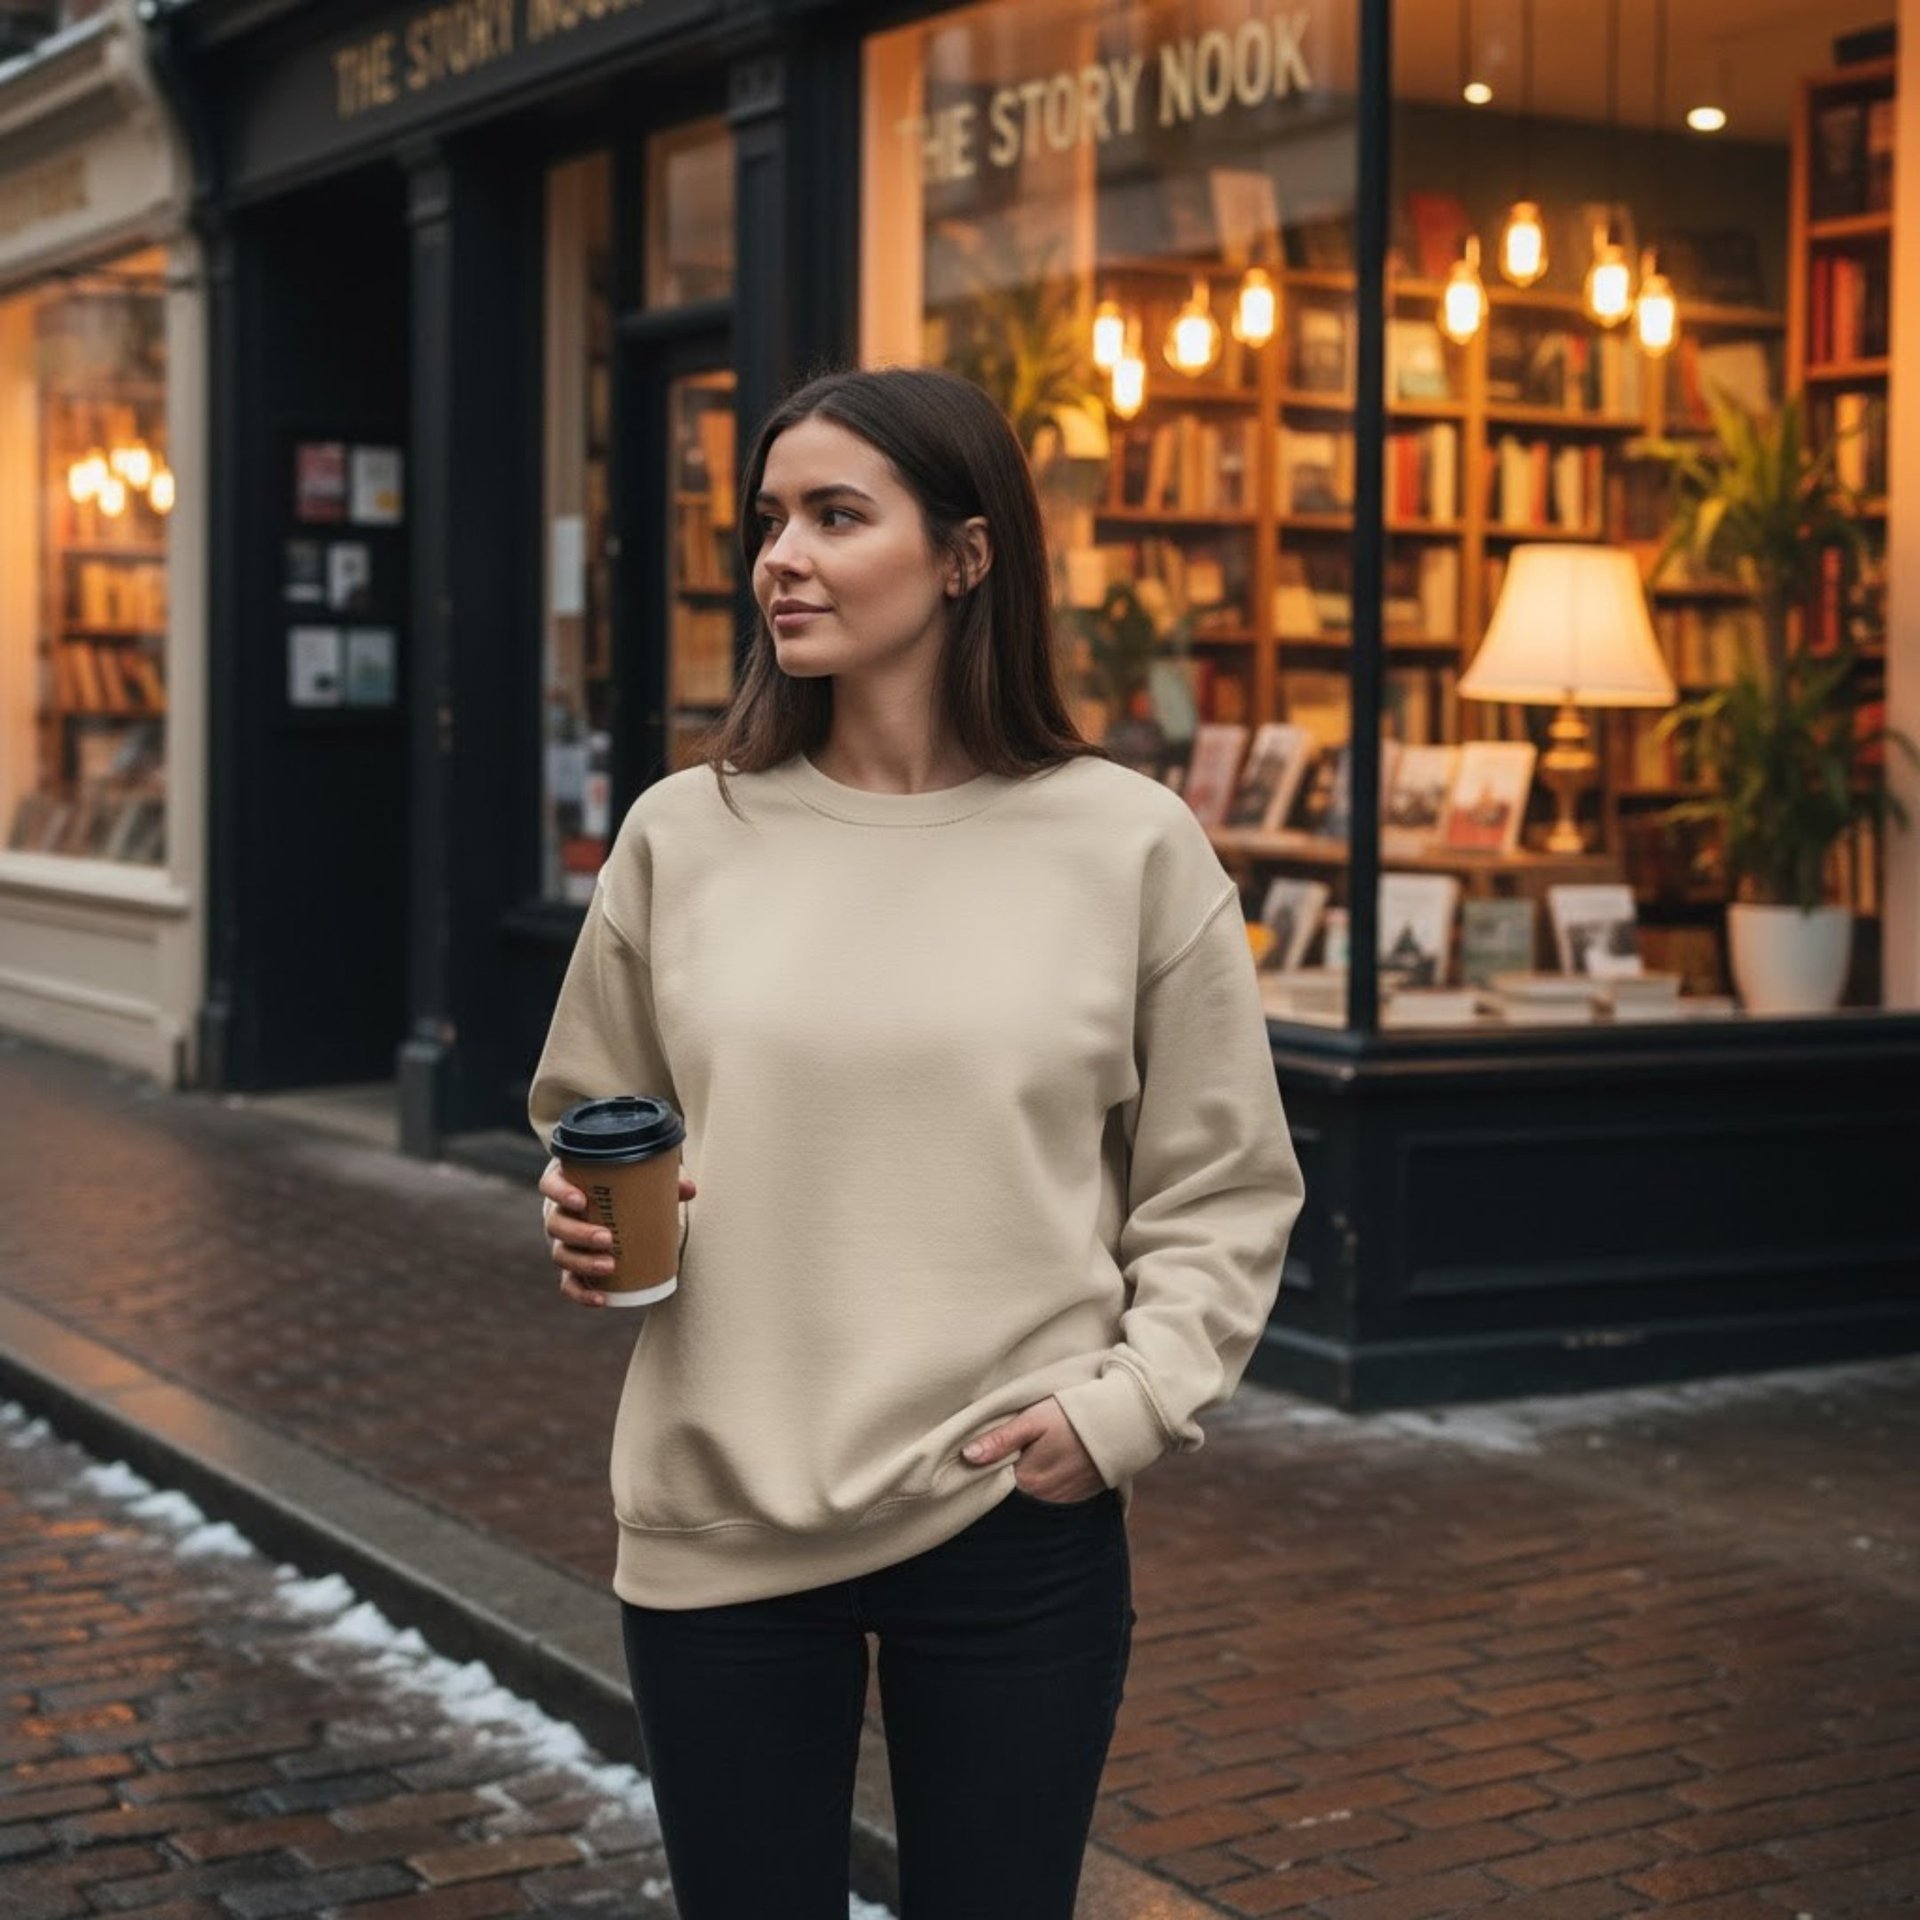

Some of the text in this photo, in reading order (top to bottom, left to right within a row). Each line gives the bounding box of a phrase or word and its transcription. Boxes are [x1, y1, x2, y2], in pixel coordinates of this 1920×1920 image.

[333, 31, 396, 119] THE
[989, 56, 1144, 167] STORY
[1159, 13, 1312, 127] NOOK
